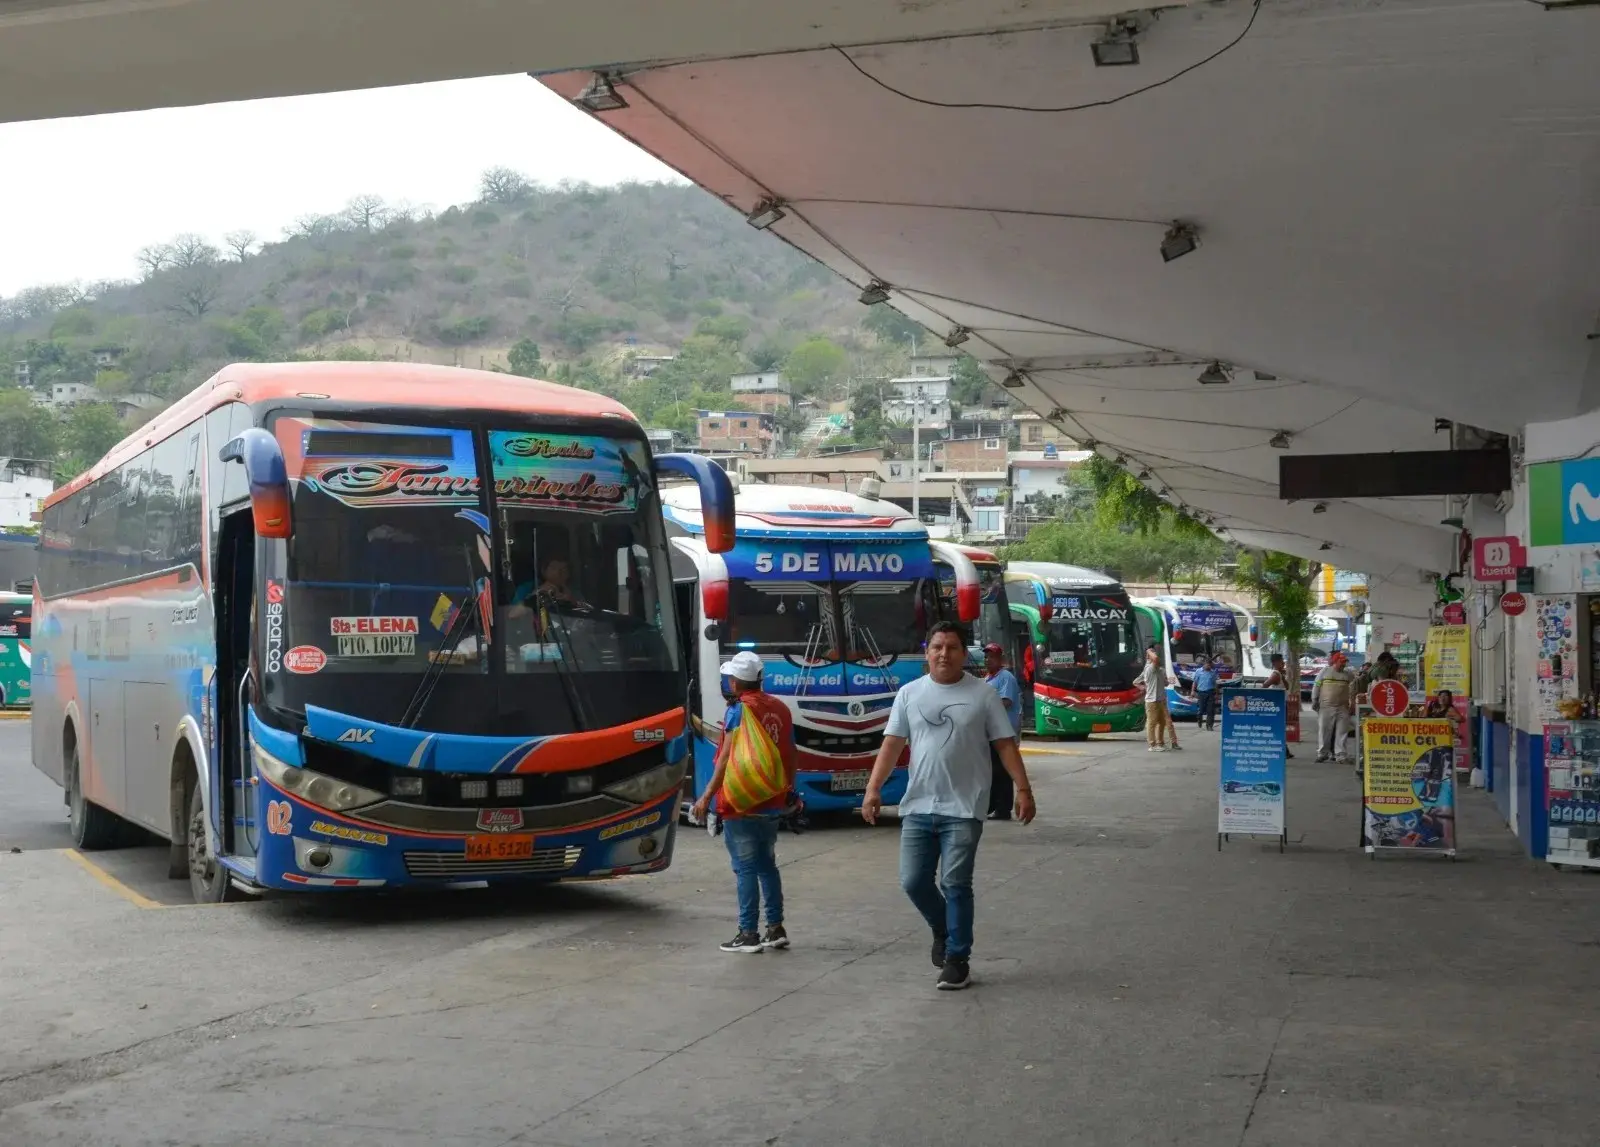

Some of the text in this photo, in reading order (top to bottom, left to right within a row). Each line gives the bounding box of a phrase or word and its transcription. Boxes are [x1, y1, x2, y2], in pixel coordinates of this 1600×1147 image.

[755, 552, 904, 573] 5 DE MAYO
[1051, 608, 1127, 619] ZARACAY
[357, 618, 417, 633] ELENA
[340, 635, 413, 655] PTO. LOPEZ
[773, 673, 900, 686] Reina del Cisne
[1385, 687, 1395, 714] Claro
[1040, 705, 1051, 716] 16
[1367, 722, 1409, 734] SERVICIO
[336, 727, 376, 744] AK
[1415, 735, 1438, 746] CEL
[266, 800, 293, 835] 02
[486, 810, 515, 824] Hino
